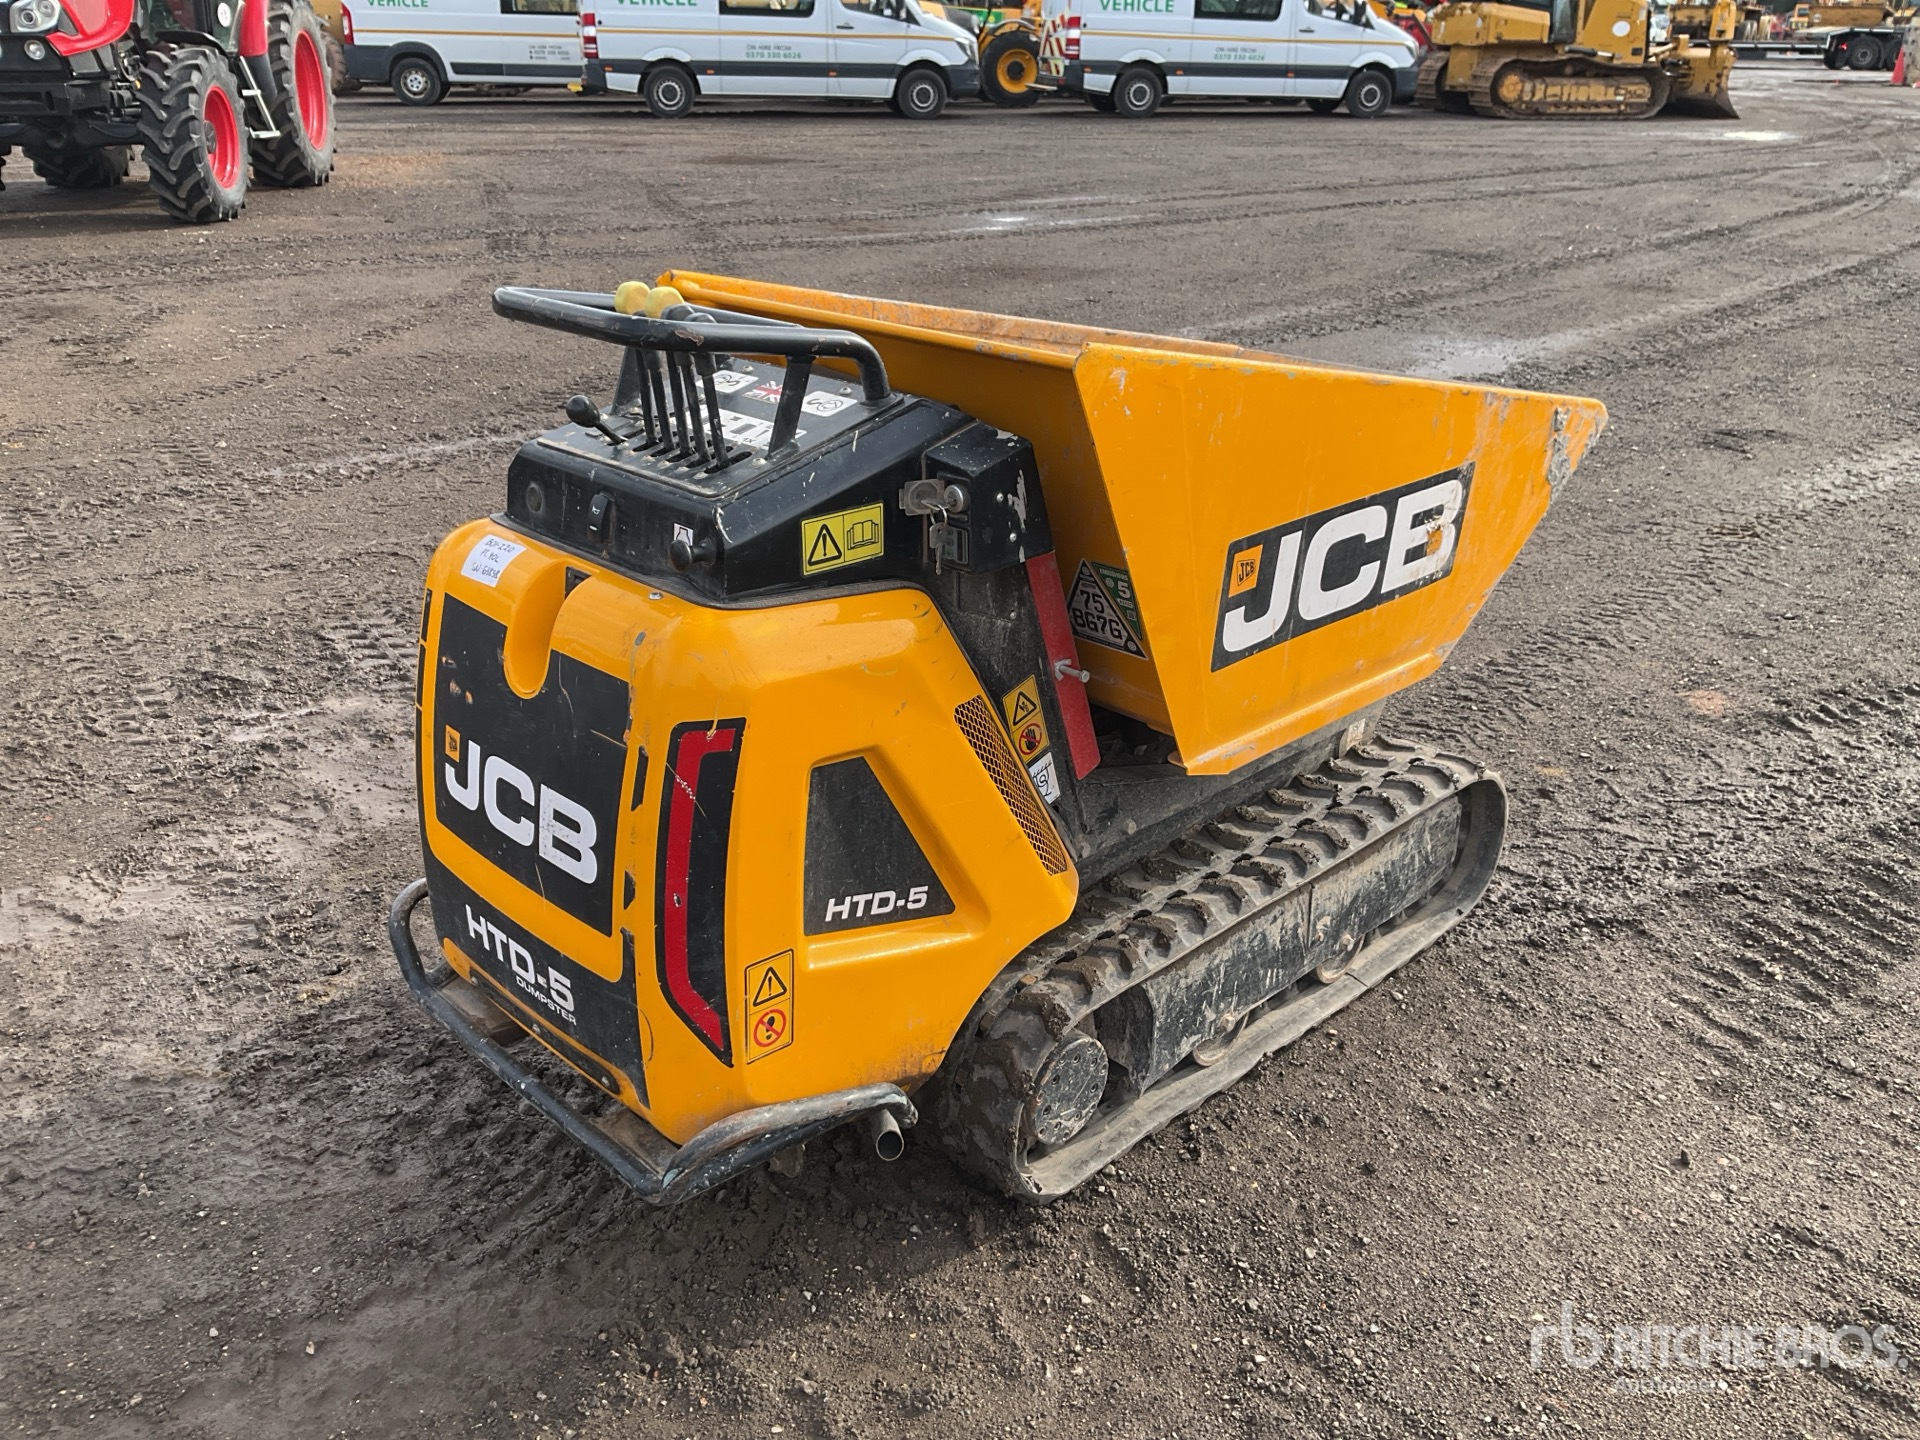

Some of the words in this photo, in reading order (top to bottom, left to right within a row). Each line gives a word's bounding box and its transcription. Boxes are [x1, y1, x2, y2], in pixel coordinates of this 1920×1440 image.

[1099, 0, 1174, 13] VEHICLE
[1222, 479, 1463, 652] JCB
[1237, 559, 1255, 583] JCB
[1079, 589, 1105, 614] 75
[1117, 580, 1131, 599] 5
[445, 739, 598, 885] JCB
[824, 885, 929, 923] HTD-5
[464, 903, 575, 1013] HTD-5
[515, 975, 577, 1027] DUMPSTER
